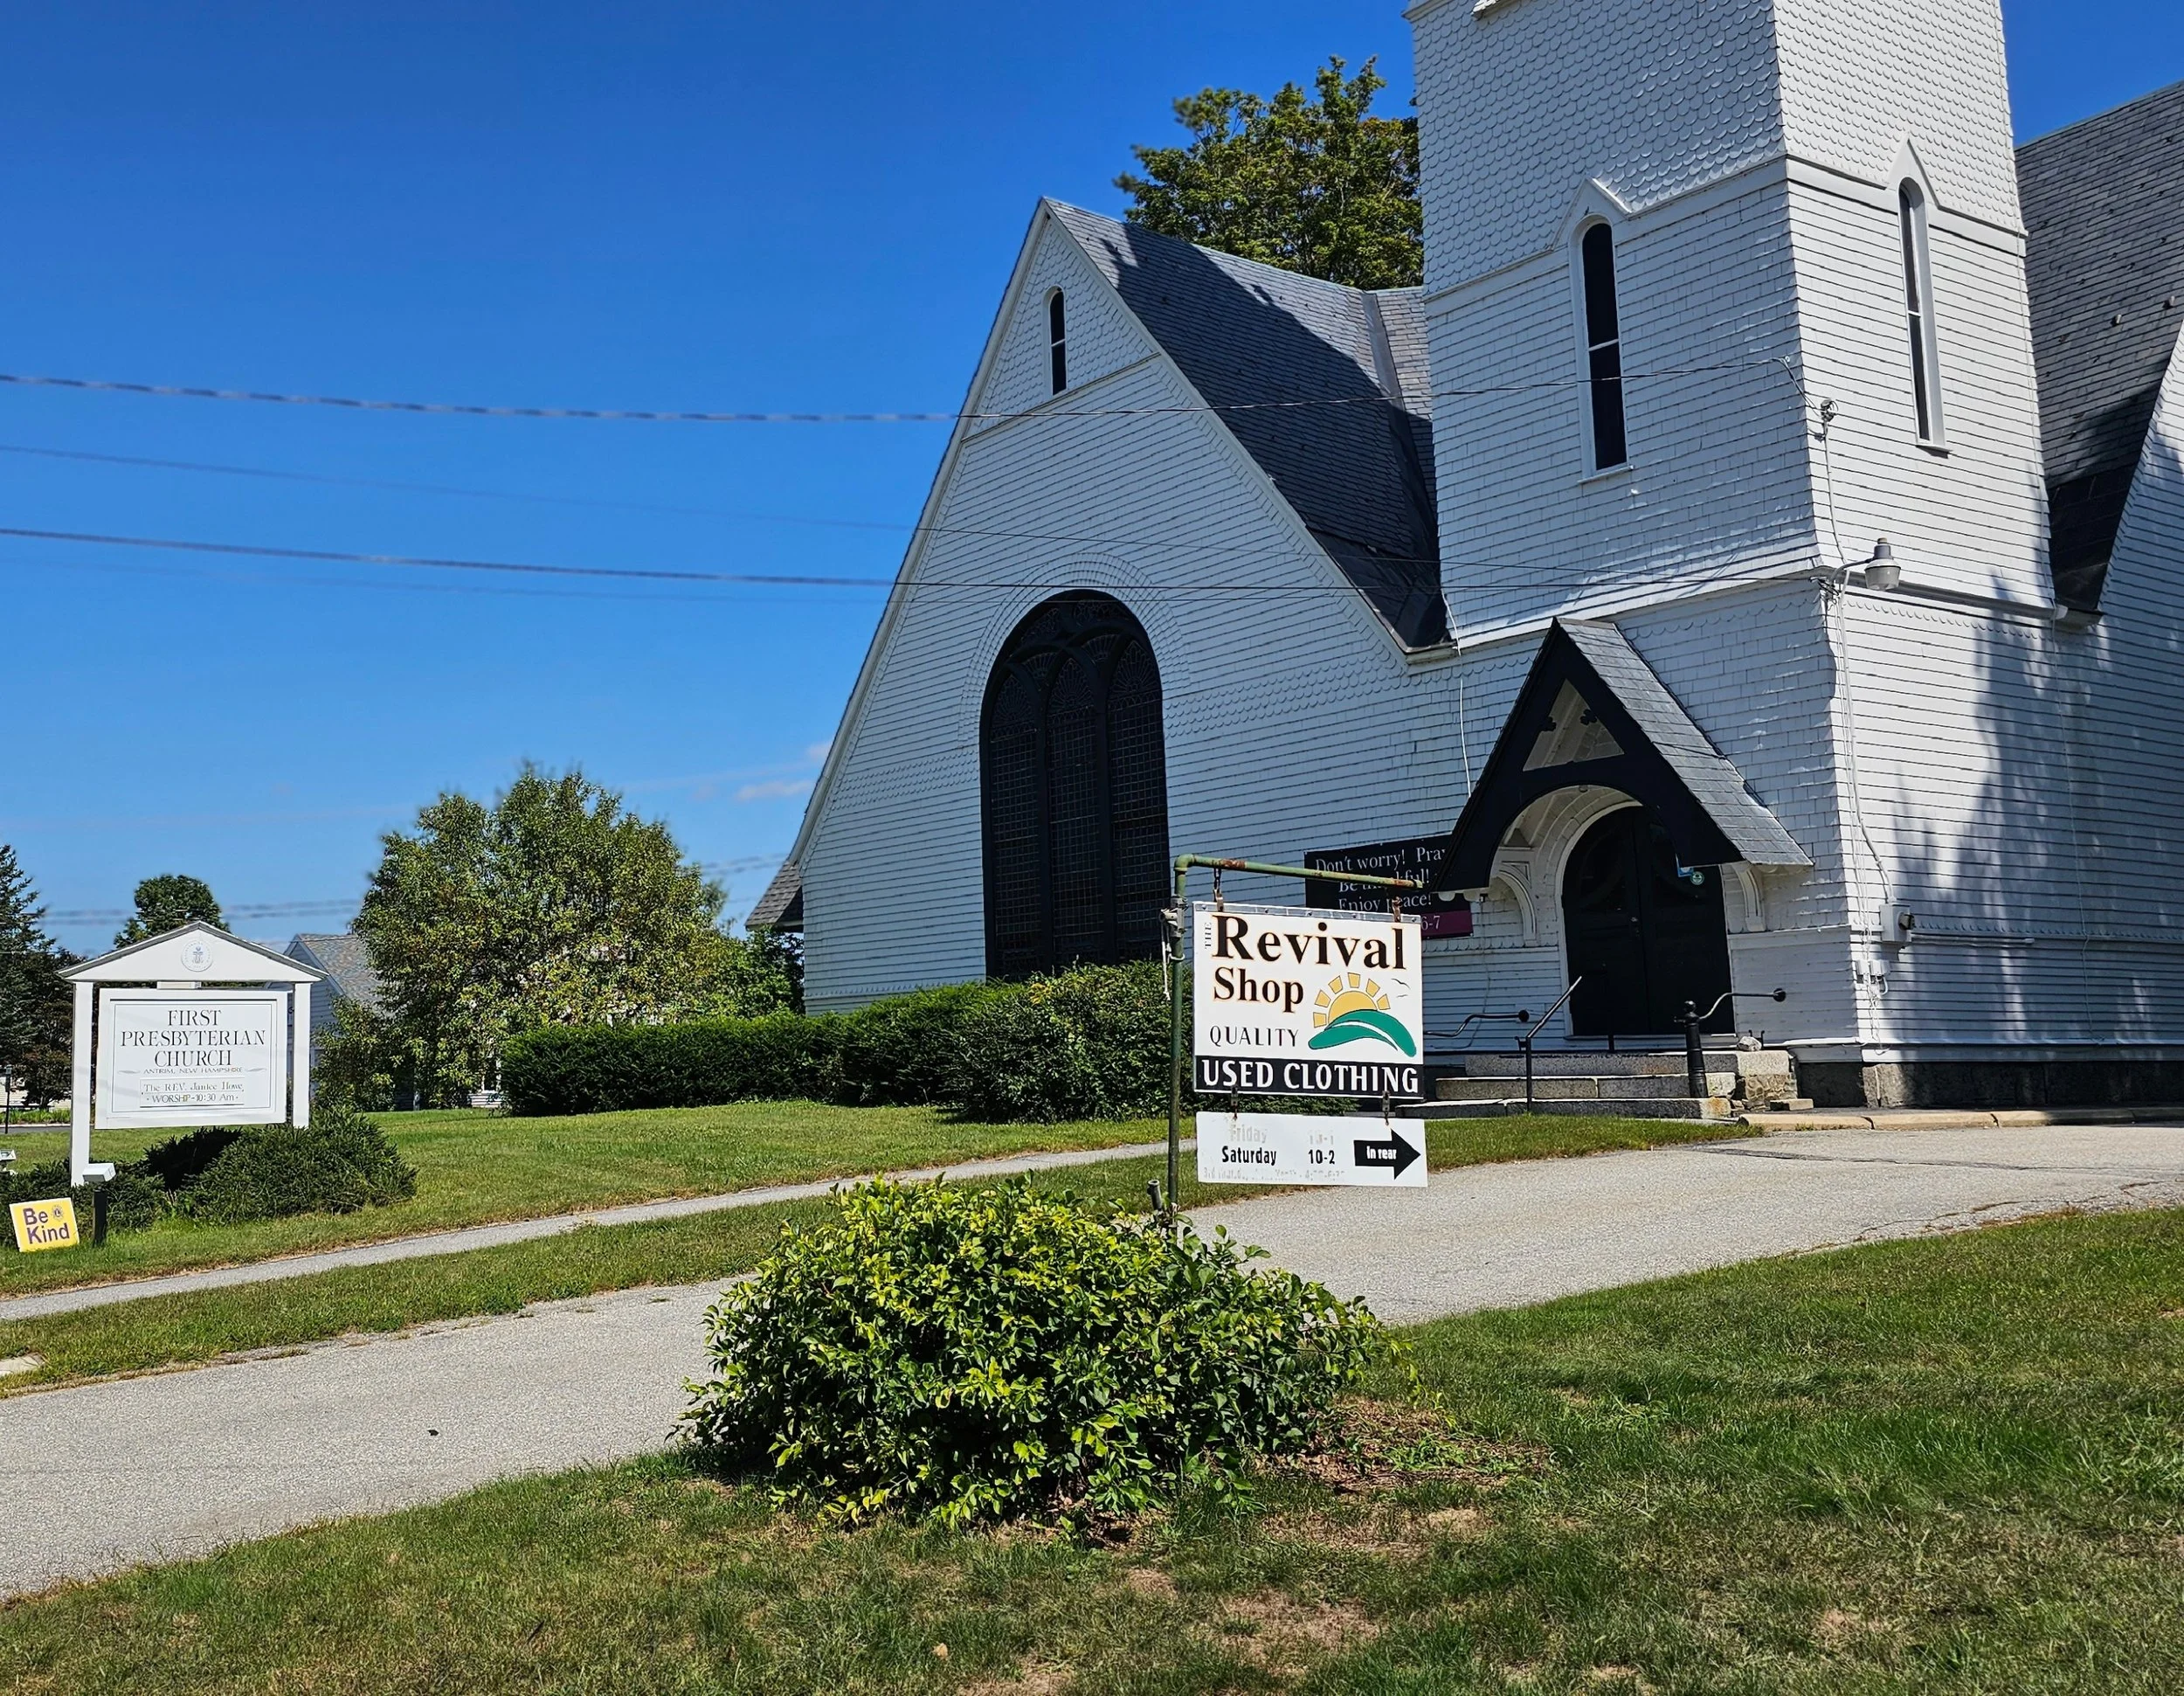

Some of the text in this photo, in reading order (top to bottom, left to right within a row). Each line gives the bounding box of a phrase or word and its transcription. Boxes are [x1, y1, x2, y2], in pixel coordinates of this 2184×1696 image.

[1316, 847, 1446, 872] Don't worry! Pra
[1338, 897, 1381, 912] Enjoy
[1204, 921, 1213, 950] THE
[1212, 914, 1406, 970] Revival
[1213, 966, 1303, 1014] Shop
[168, 1009, 221, 1026] FIRST
[121, 1029, 266, 1047] PRESBYTERIAN
[1209, 1025, 1299, 1047] QUALITY
[155, 1049, 232, 1067] CHURCH
[1201, 1059, 1418, 1094] USED CLOTHING
[144, 1083, 160, 1092] The
[1221, 1145, 1336, 1166] Saturday 10-2
[1378, 1148, 1397, 1160] rear
[23, 1208, 48, 1225] Be
[26, 1223, 70, 1244] Kind
